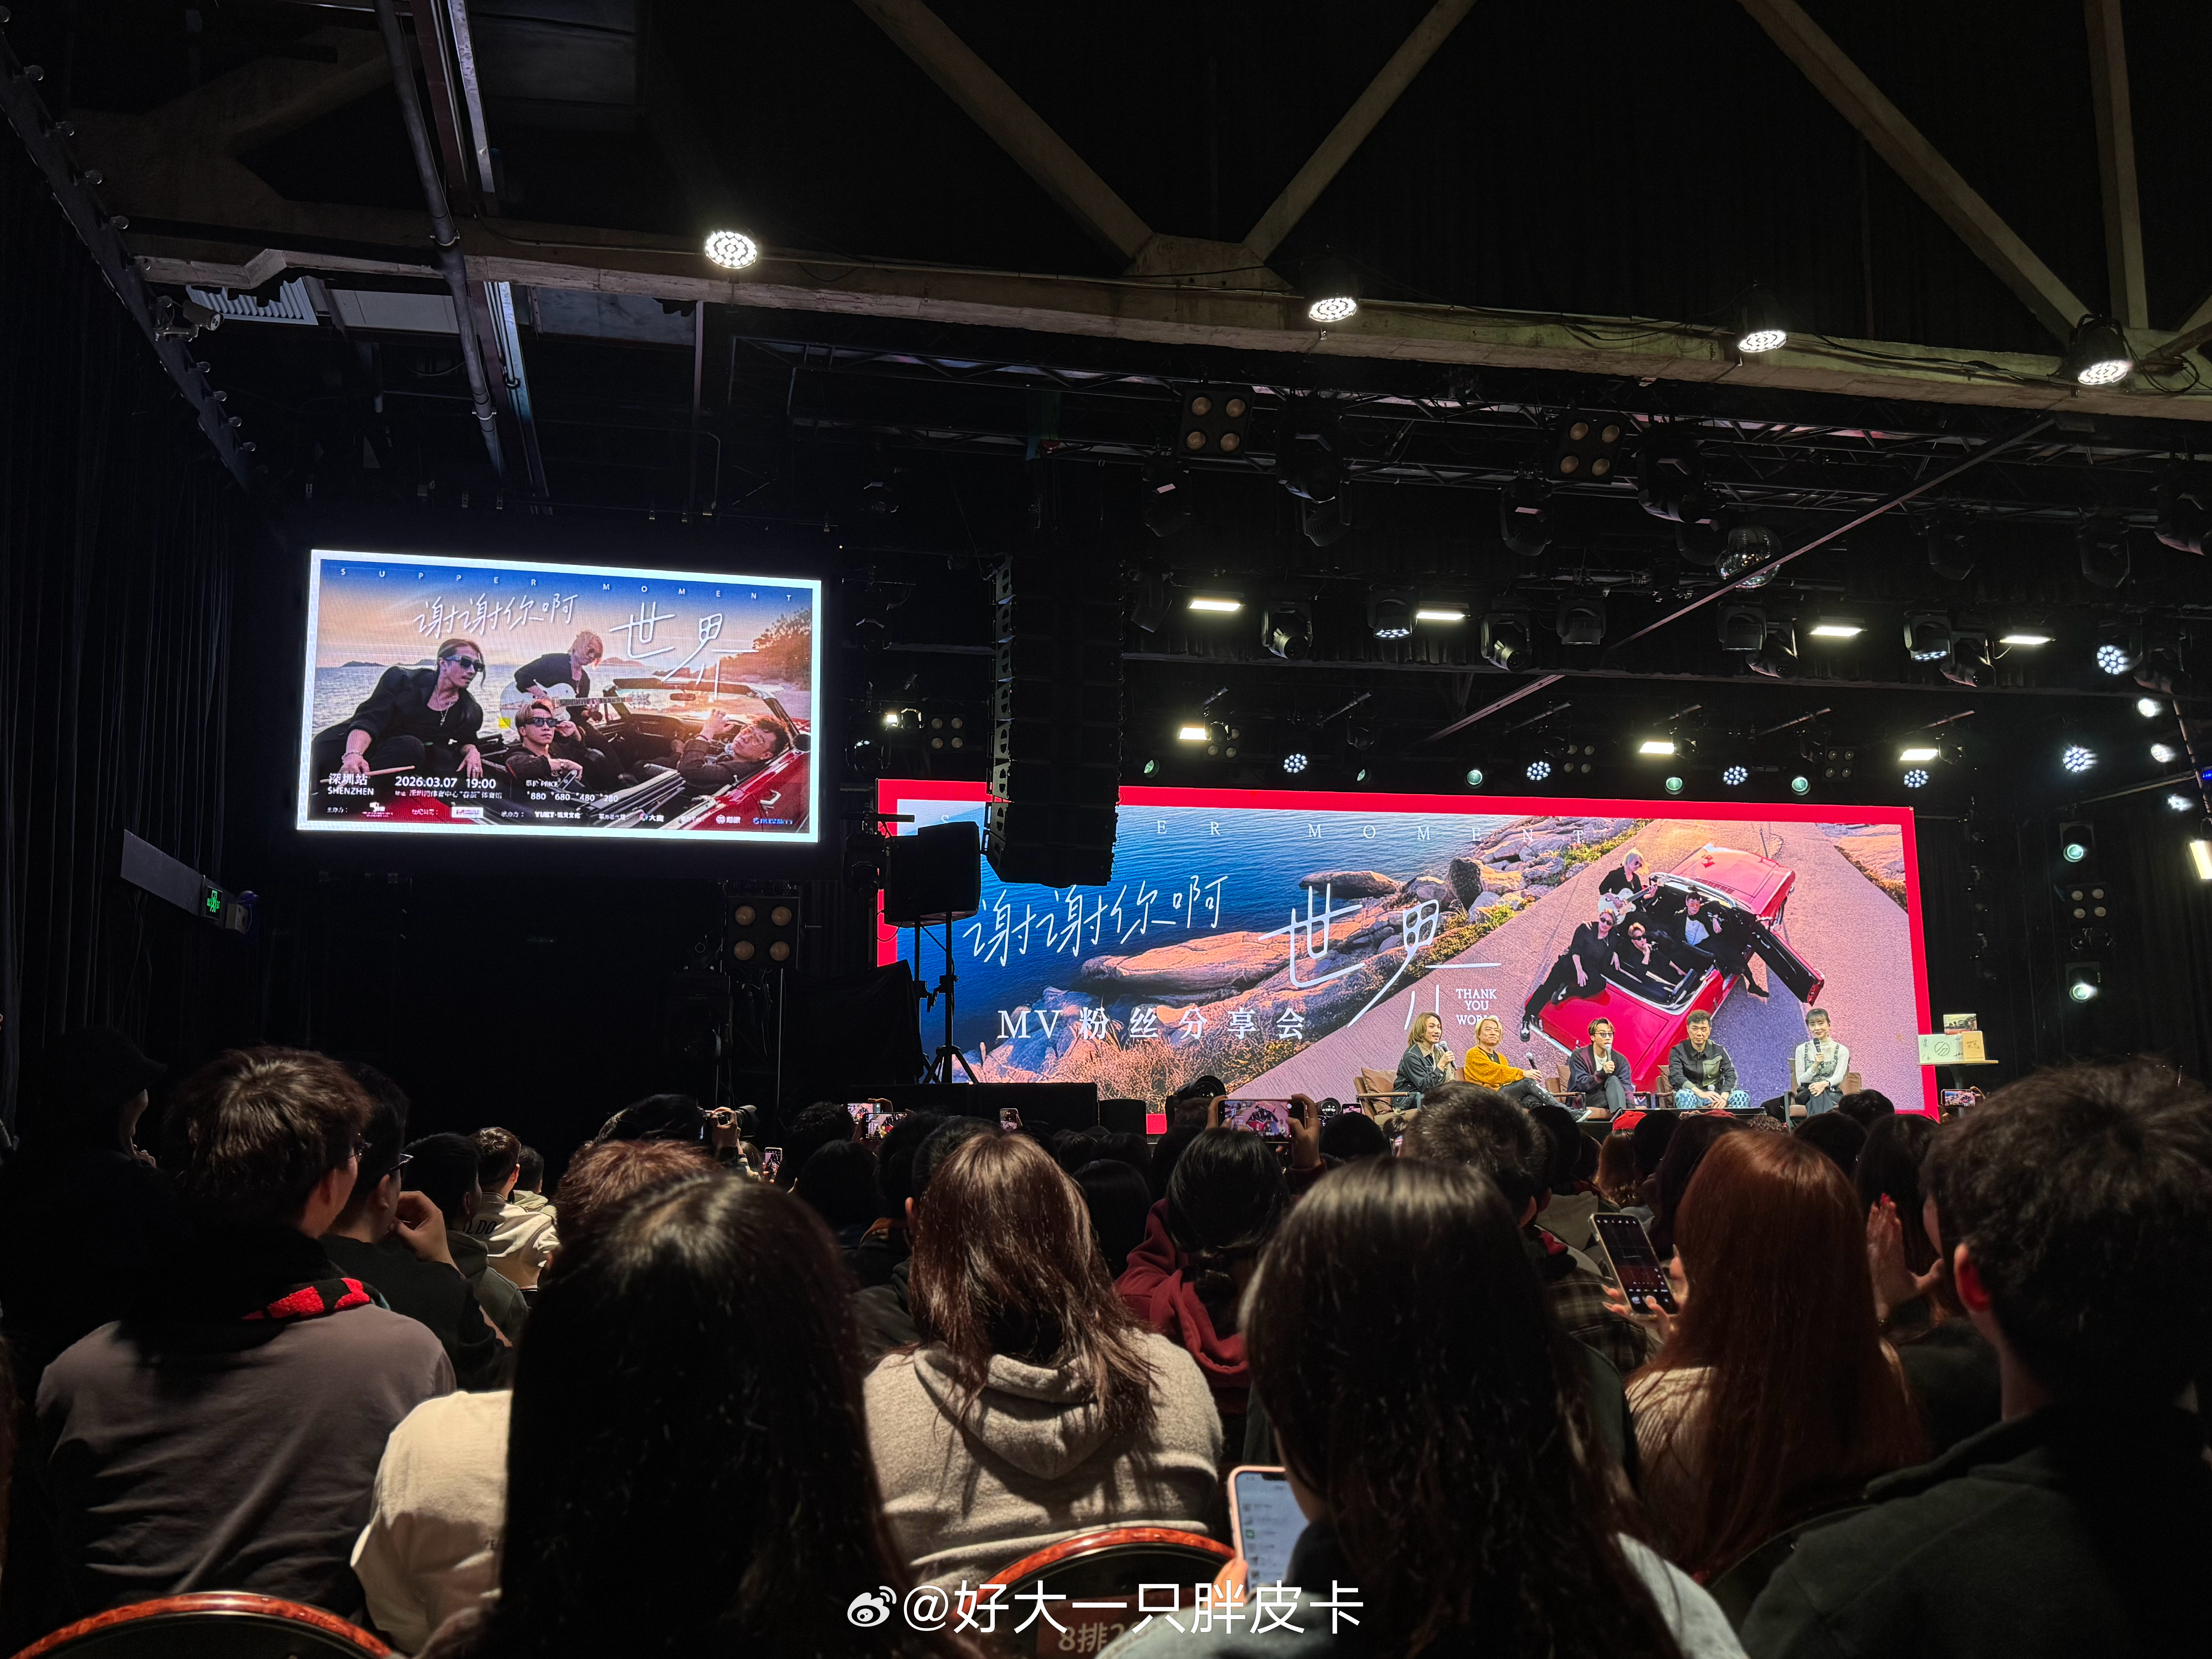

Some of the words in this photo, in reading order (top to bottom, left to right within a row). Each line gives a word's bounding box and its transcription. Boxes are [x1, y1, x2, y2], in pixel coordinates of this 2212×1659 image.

[608, 601, 759, 700] 世界
[329, 773, 368, 785] 深圳站
[394, 776, 458, 788] 2026.03.07
[466, 778, 496, 789] 19:00
[328, 787, 374, 795] SHENZHEN
[1307, 823, 1584, 844] MOMENT
[1456, 988, 1497, 999] THANK
[1464, 1000, 1489, 1011] YOU
[1455, 1015, 1499, 1025] WOR
[1058, 1622, 1140, 1653] 8排2
